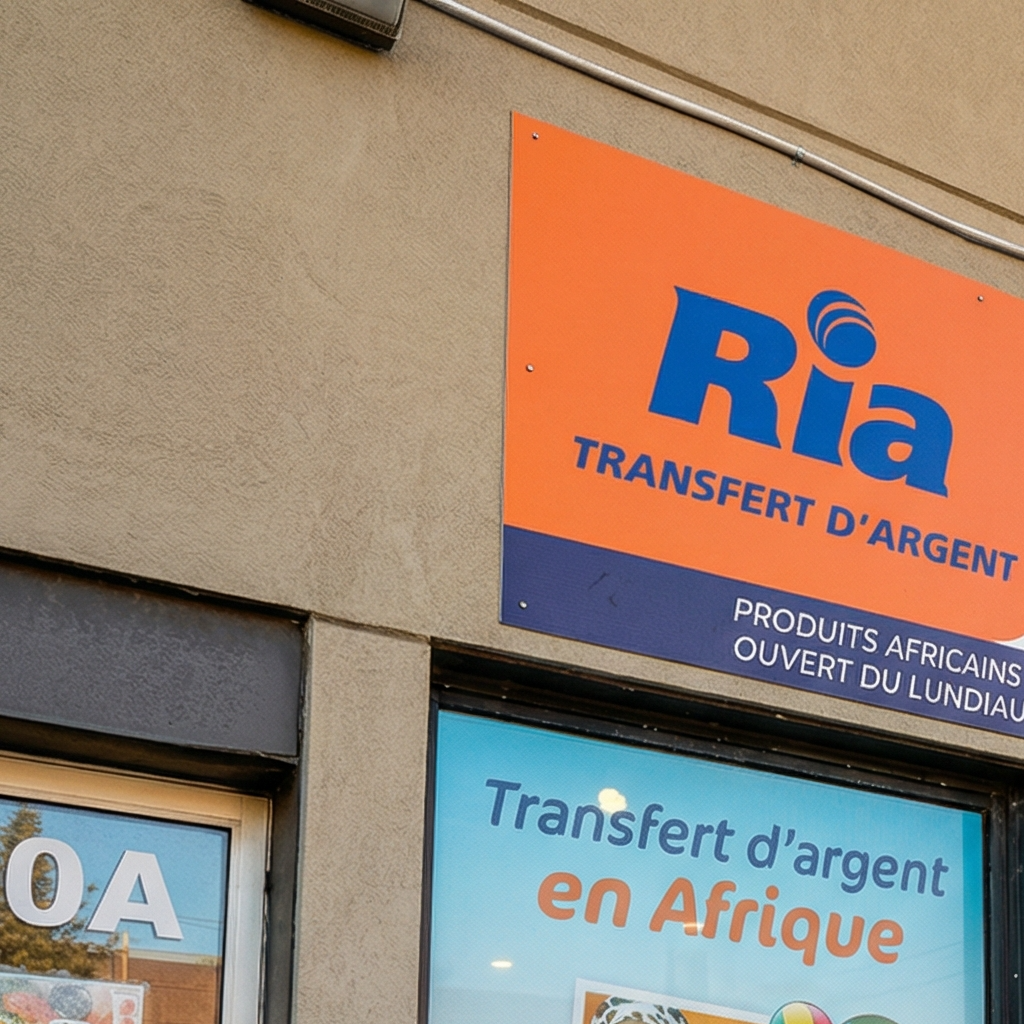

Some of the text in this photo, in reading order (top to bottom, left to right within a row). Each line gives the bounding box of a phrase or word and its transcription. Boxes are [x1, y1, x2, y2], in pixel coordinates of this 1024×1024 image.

[648, 284, 954, 498] Ria
[573, 435, 1019, 583] TRANSFERT D'ARGENT
[733, 597, 879, 652] PRODUITS
[885, 634, 1022, 688] AFRICAINS
[733, 635, 854, 684] OUVERT
[859, 664, 901, 695] DU
[485, 778, 951, 898] Transfert d'argent
[537, 871, 905, 967] en Afrique
